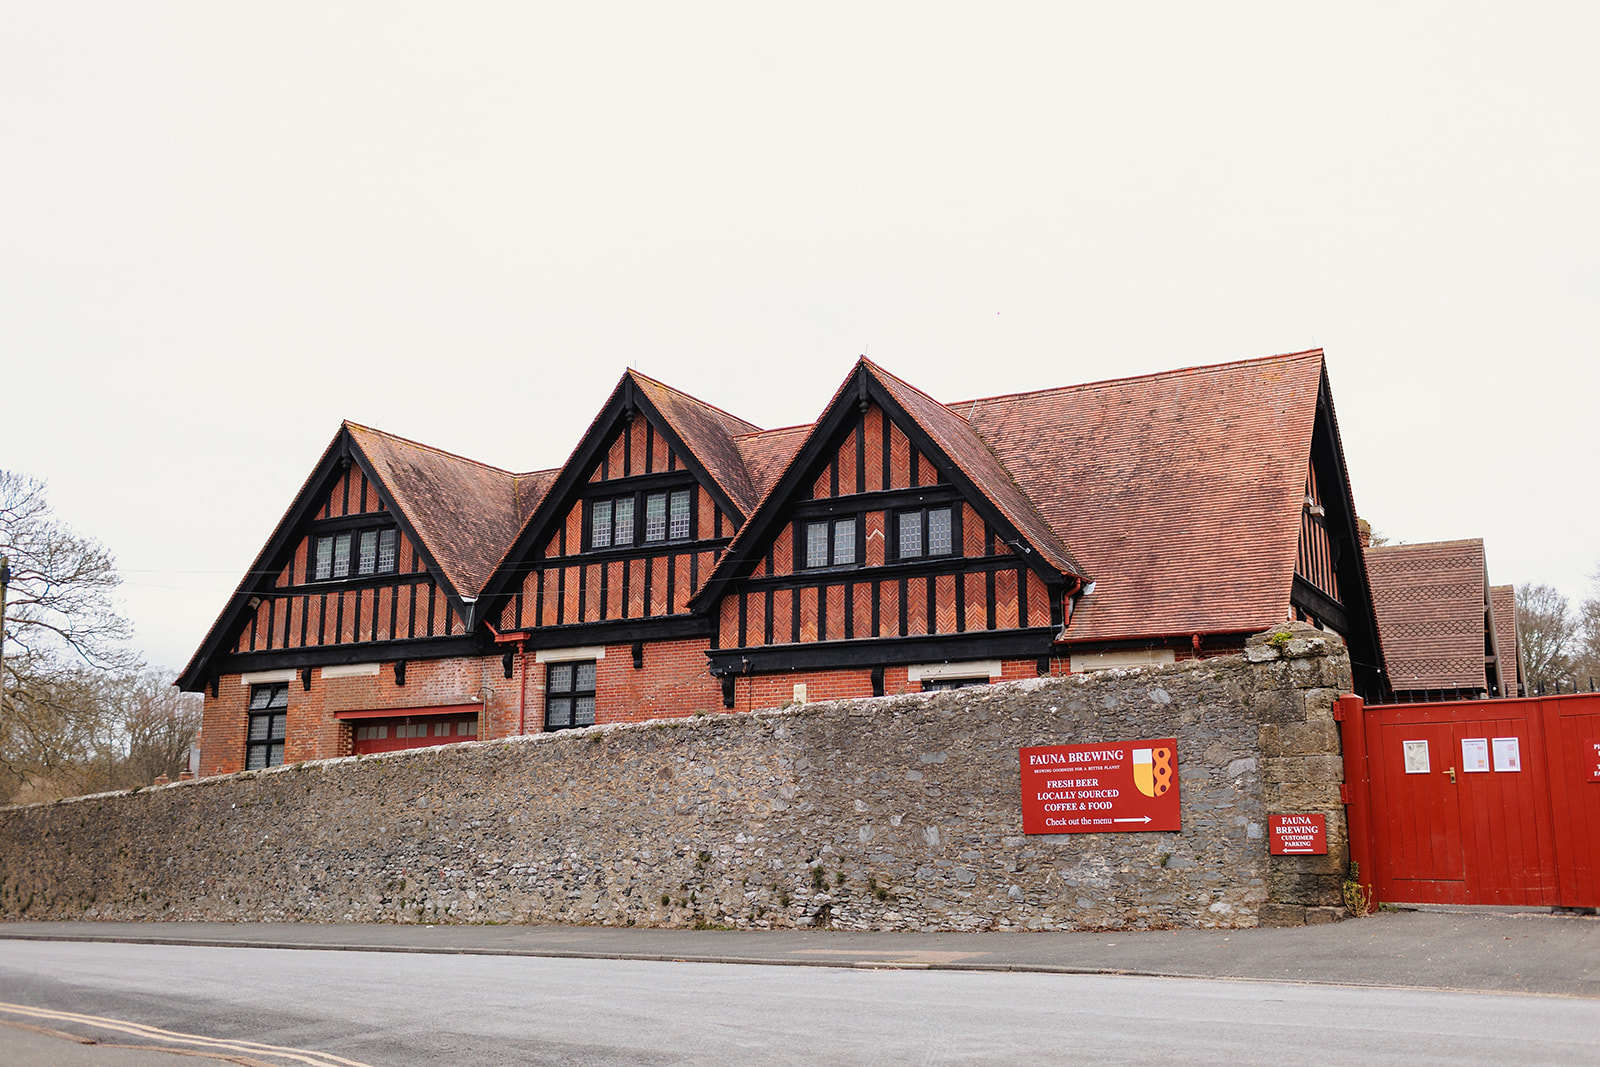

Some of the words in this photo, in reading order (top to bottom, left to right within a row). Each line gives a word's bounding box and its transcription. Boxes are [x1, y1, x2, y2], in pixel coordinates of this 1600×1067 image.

[1029, 753, 1066, 765] FAUNA
[1068, 749, 1124, 763] BREWING
[1047, 780, 1074, 789] FRESH
[1075, 778, 1099, 787] BEER
[1037, 791, 1076, 801] LOCALLY
[1077, 789, 1119, 799] SOURCED
[1044, 803, 1078, 812] COFFEE
[1079, 802, 1086, 810] &
[1088, 801, 1113, 810] FOOD
[1045, 817, 1067, 826] Check
[1080, 816, 1092, 825] the
[1281, 816, 1311, 824] FAUNA
[1275, 826, 1318, 834] BREWING
